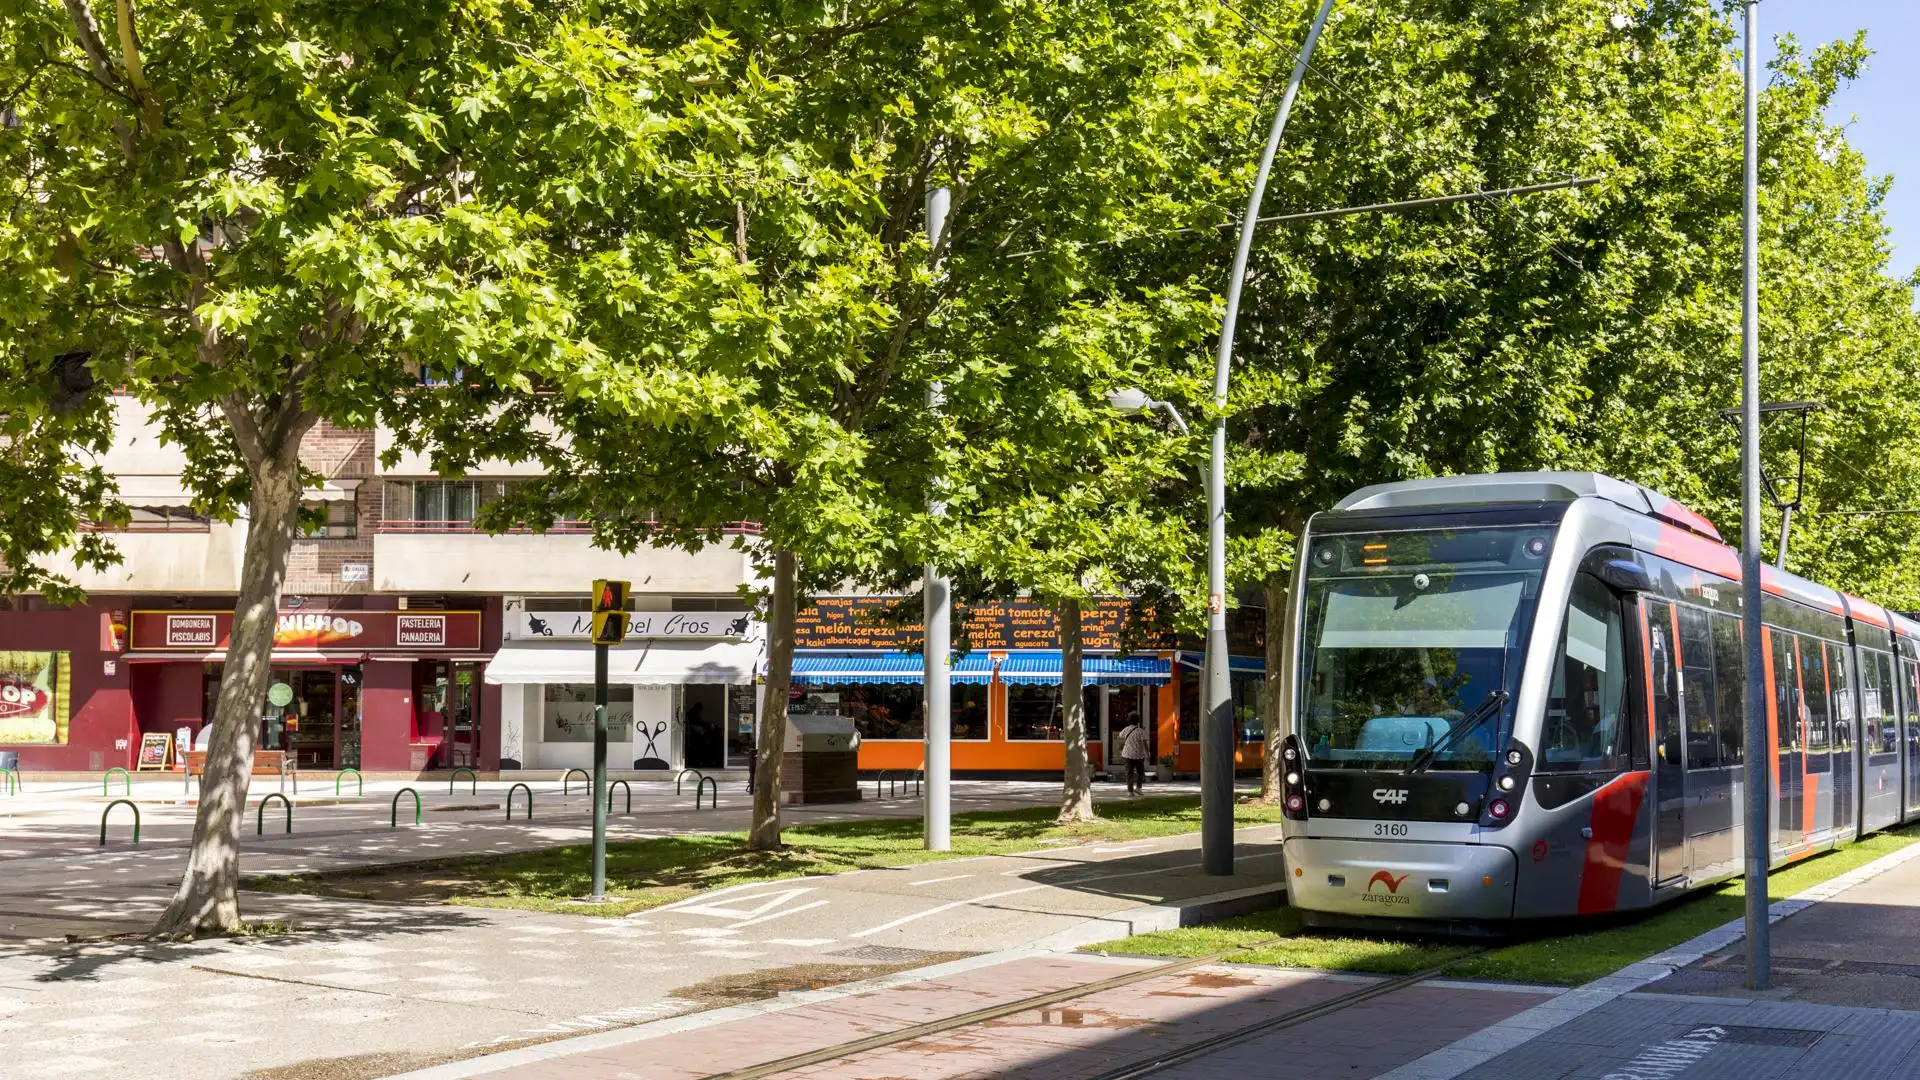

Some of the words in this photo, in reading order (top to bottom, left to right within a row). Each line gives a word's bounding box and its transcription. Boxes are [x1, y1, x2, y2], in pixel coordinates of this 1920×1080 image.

[1008, 607, 1052, 618] tomate
[1080, 610, 1119, 621] pera
[172, 619, 211, 628] BOMBONERIA
[275, 614, 363, 637] NISHOP
[401, 619, 441, 628] PASTELERIA
[663, 614, 710, 635] Cros
[815, 622, 852, 635] melón
[171, 632, 211, 641] PISCOLABIS
[401, 632, 441, 642] PANADERIA
[853, 626, 897, 637] cereza
[968, 628, 1001, 639] melón
[1013, 629, 1056, 639] cereza
[826, 636, 870, 646] albaricoque
[986, 639, 1007, 647] pera
[1015, 640, 1050, 649] aguacate
[1372, 788, 1409, 805] CAF
[1374, 823, 1408, 837] 3160
[1361, 893, 1411, 908] zaragoza
